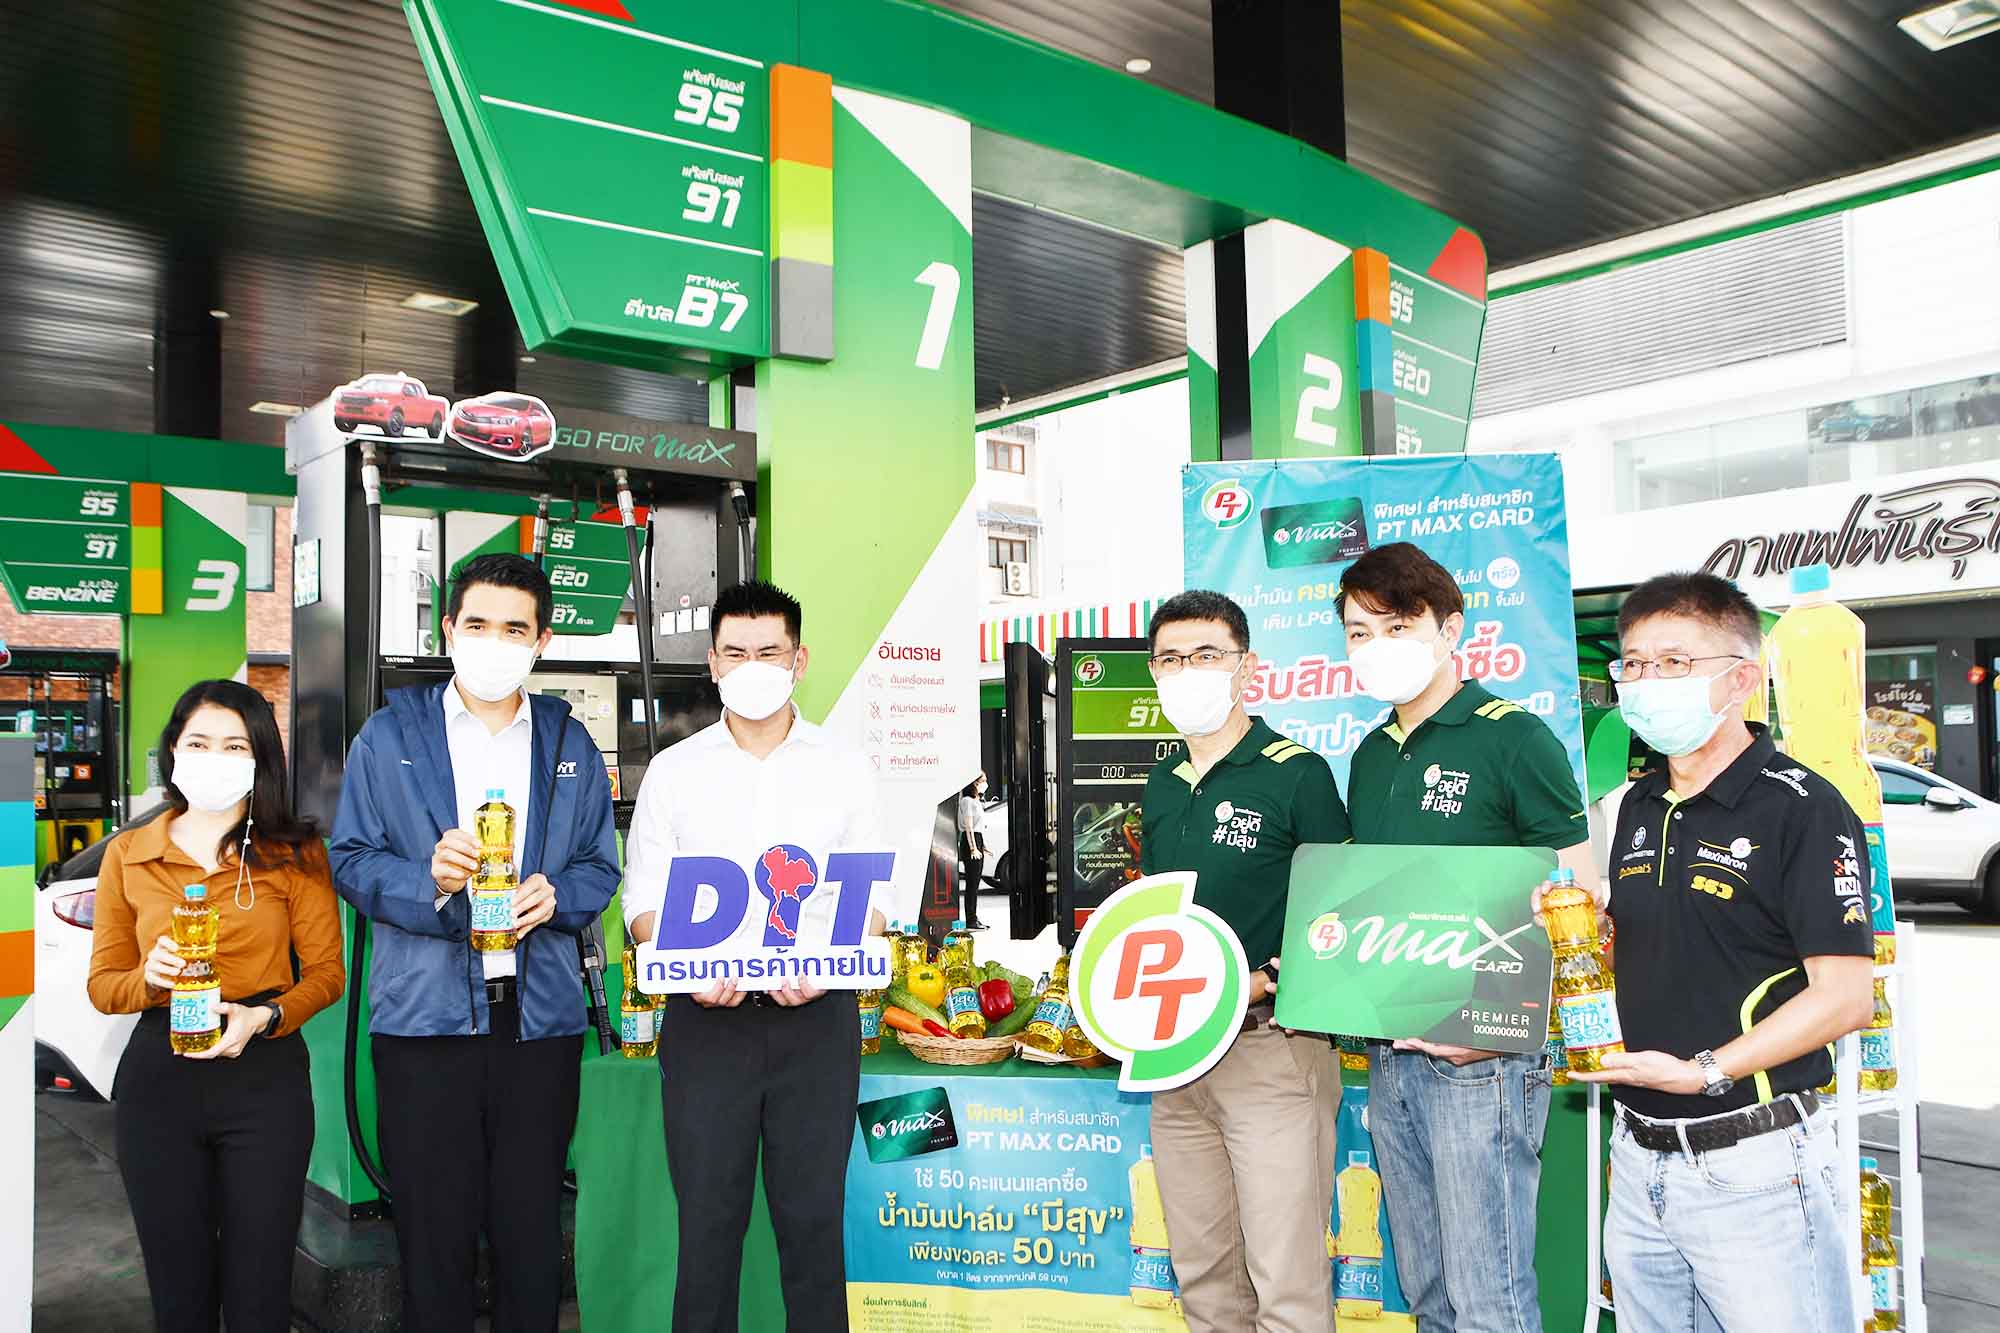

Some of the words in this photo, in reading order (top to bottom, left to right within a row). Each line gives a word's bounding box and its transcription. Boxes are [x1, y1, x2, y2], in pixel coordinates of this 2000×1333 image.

[674, 83, 744, 133] 95
[681, 181, 741, 229] 91
[675, 285, 749, 333] B7
[914, 261, 961, 369] 1
[1390, 289, 1414, 323] 95
[1392, 357, 1430, 396] E20
[1294, 353, 1343, 447] 2
[555, 427, 592, 448] GO
[595, 432, 645, 454] FOR
[80, 497, 118, 516] 95
[1214, 491, 1242, 519] PT
[1427, 488, 1534, 514] สำหรับสมาชิก
[1376, 521, 1407, 541] PT
[1411, 513, 1464, 538] MAX
[1468, 507, 1535, 530] CARD
[85, 540, 117, 560] 91
[550, 532, 576, 549] 95
[185, 560, 240, 612] 3
[549, 570, 589, 588] E20
[25, 585, 117, 604] BENZINE
[551, 607, 577, 625] B7
[1296, 611, 1334, 629] LPG
[878, 641, 941, 662] อันตราย
[1081, 662, 1099, 680] PT
[1127, 706, 1160, 728] 91
[1421, 790, 1463, 818] #มีสุข
[1212, 824, 1257, 852] #มีสุข
[1317, 924, 1338, 949] PT
[1472, 959, 1523, 974] CARD
[1113, 929, 1207, 1041] PT
[1461, 1009, 1530, 1026] PREMIER
[1029, 1107, 1120, 1129] สำหรับสมาชิก
[967, 1131, 994, 1151] PT
[1000, 1133, 1052, 1152] MAX
[1057, 1133, 1122, 1154] CARD
[914, 1167, 933, 1189] ใช้
[939, 1170, 964, 1189] 50
[968, 1167, 1088, 1192] คะแนนแลกซื้อ
[878, 1191, 1015, 1233] น้ำมันปาล์ม
[909, 1241, 1006, 1266] เพียงขวดละ
[1012, 1237, 1055, 1265] 50
[1060, 1255, 1096, 1269] บาท
